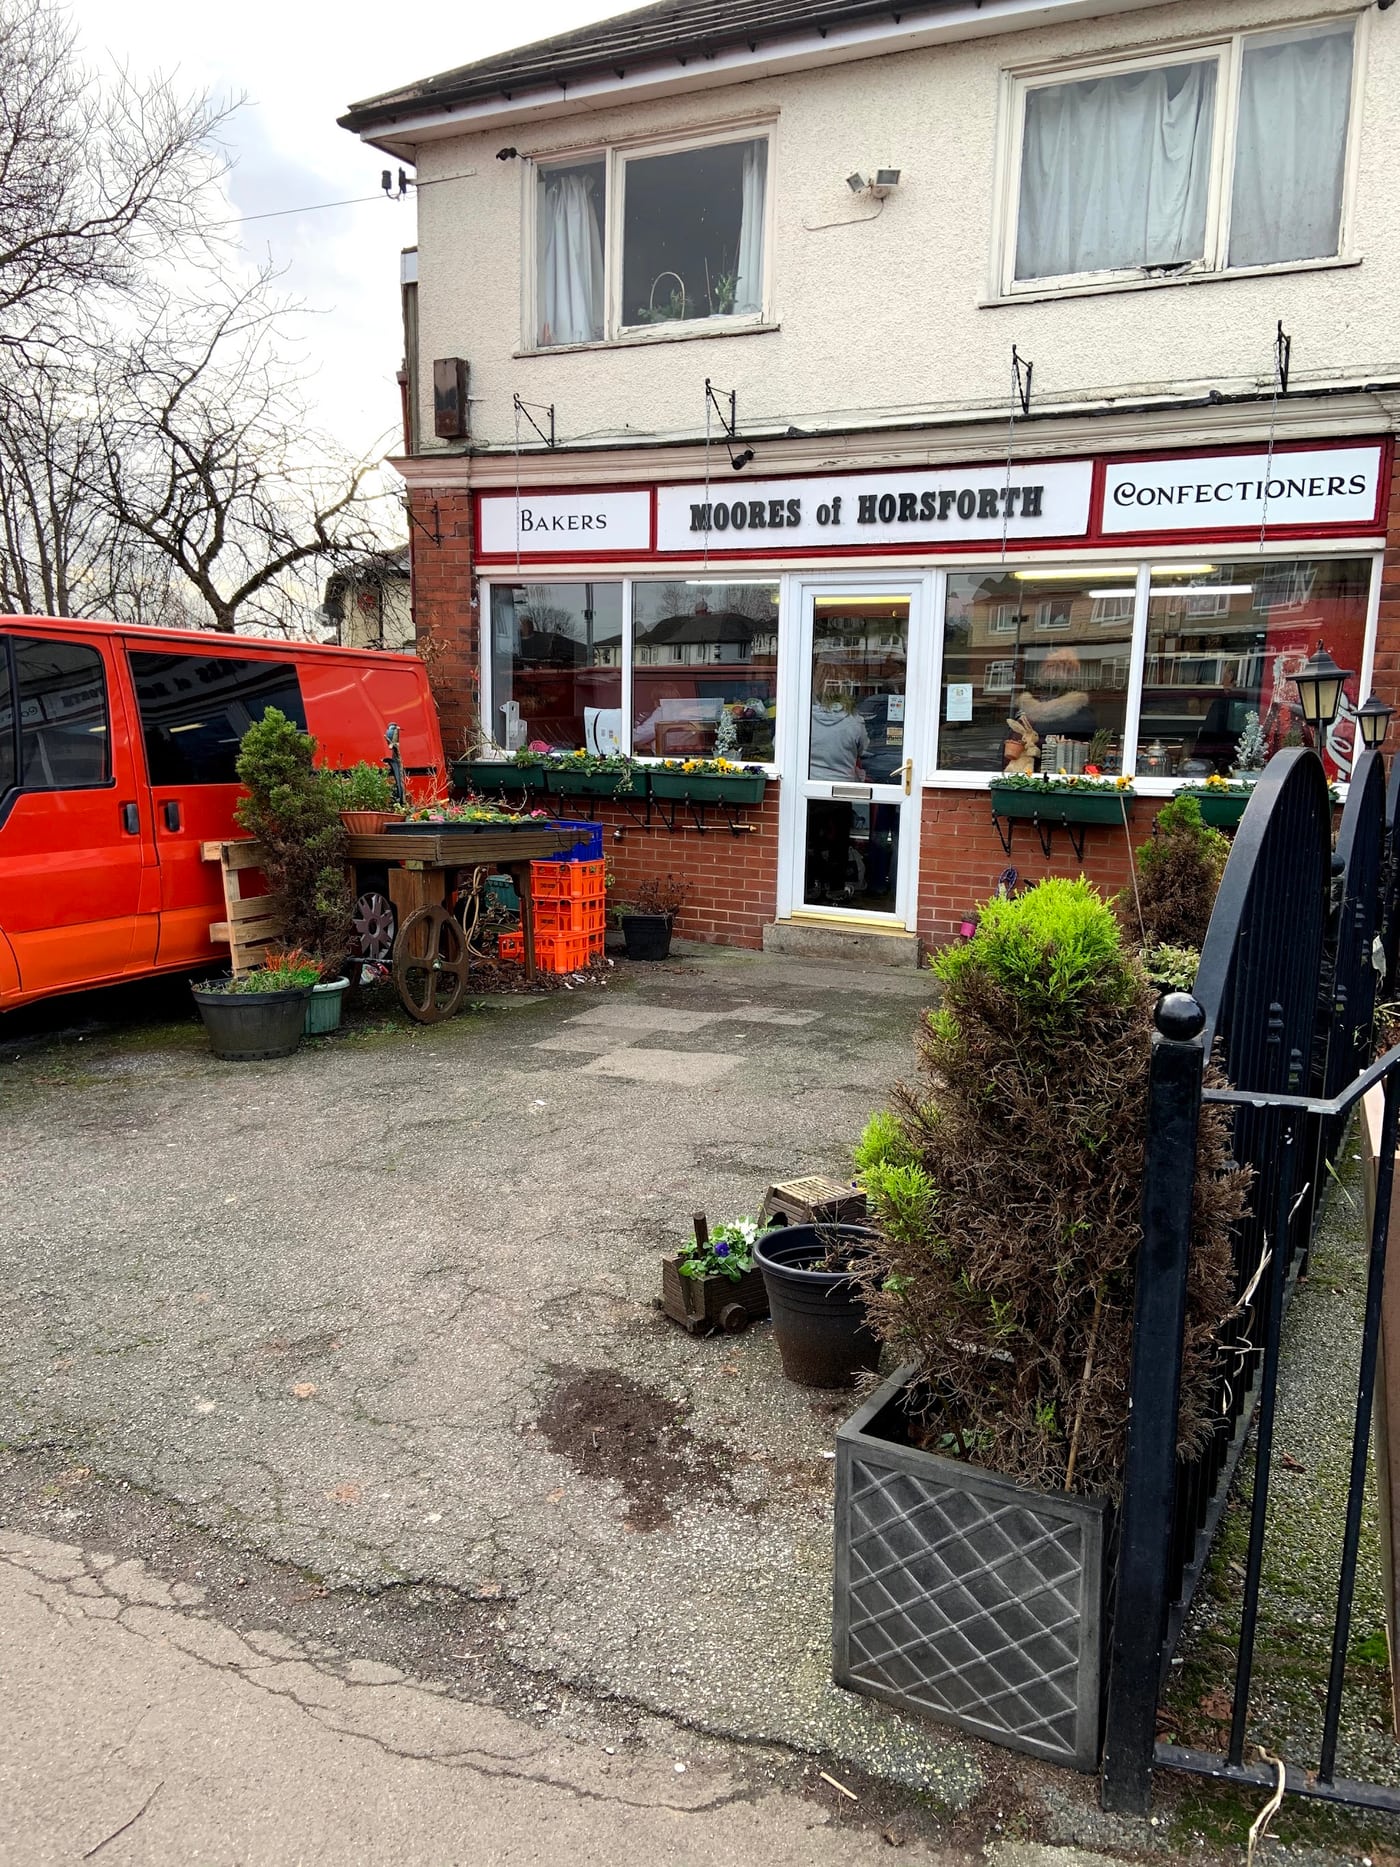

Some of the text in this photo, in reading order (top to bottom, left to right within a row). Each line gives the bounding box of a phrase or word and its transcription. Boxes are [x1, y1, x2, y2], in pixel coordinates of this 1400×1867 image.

[1113, 474, 1366, 506] CONFECTIONERS
[520, 509, 608, 532] BAKERS
[689, 486, 1044, 532] MOORES of HORSFORTH
